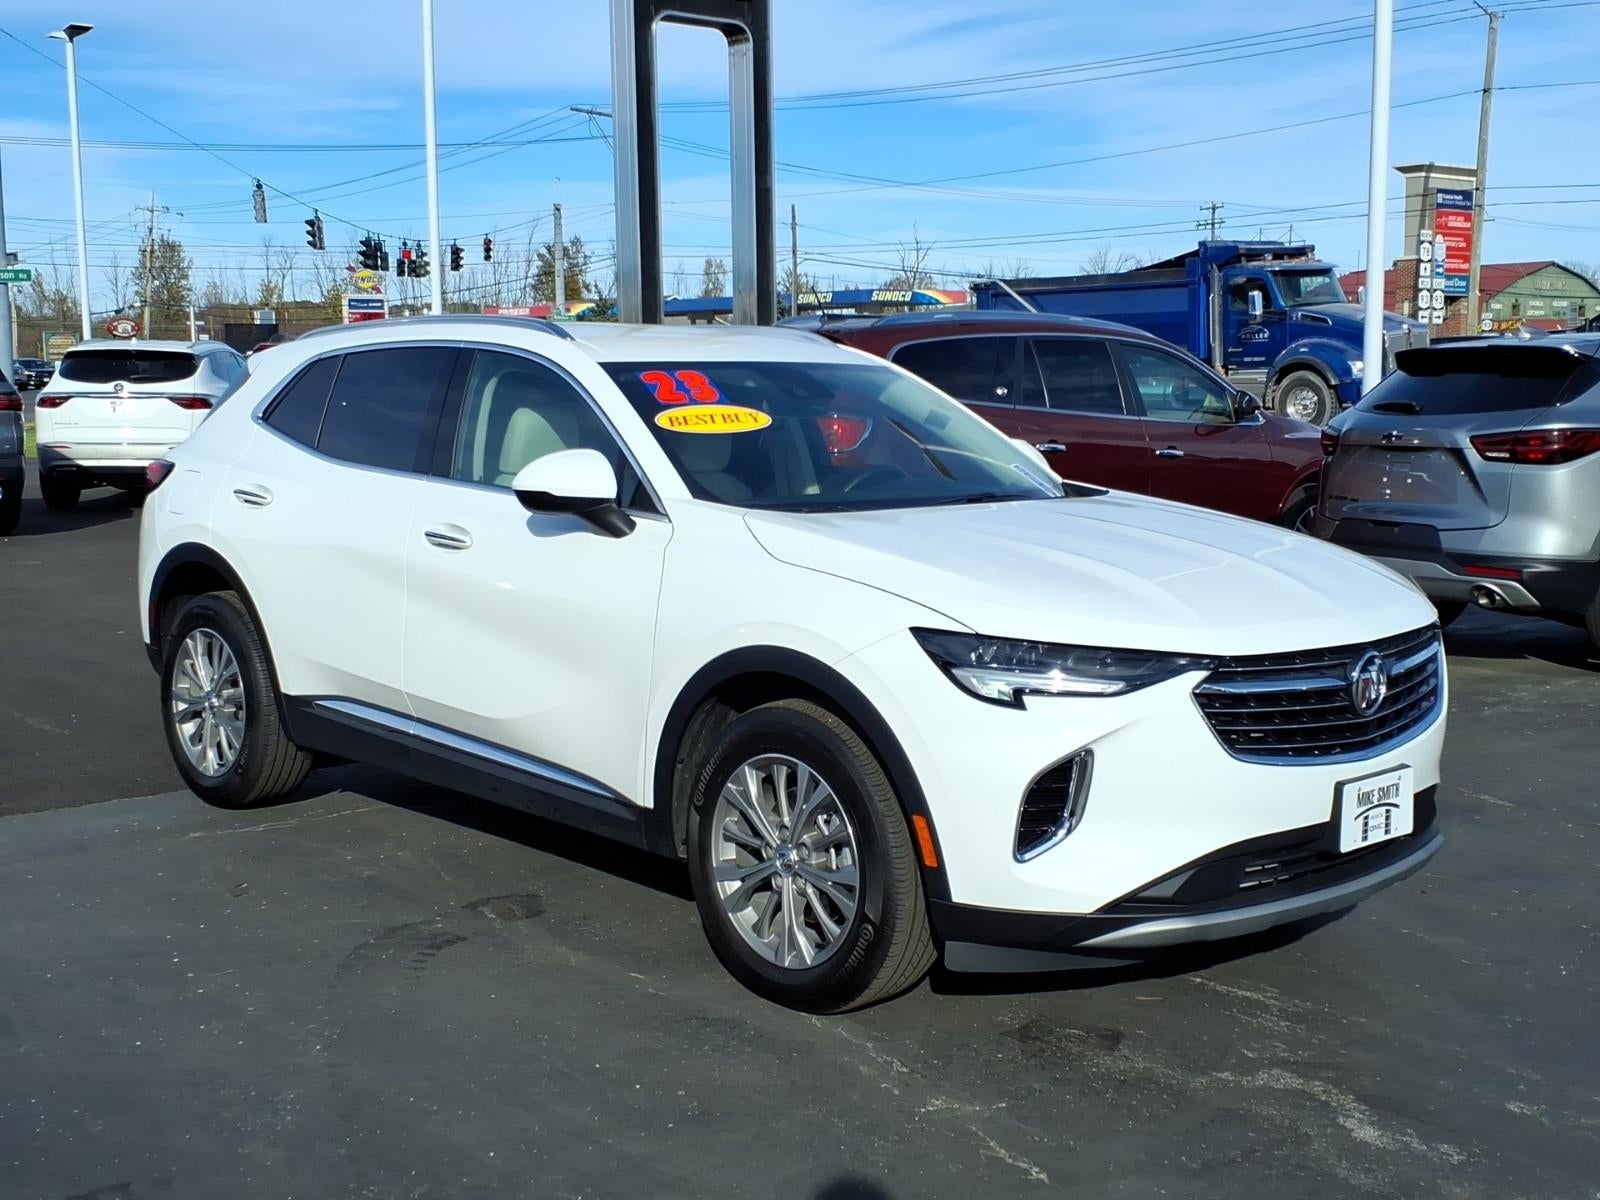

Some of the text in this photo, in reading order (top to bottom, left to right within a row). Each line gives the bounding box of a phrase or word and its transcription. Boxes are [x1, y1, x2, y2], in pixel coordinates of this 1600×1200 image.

[1423, 246, 1430, 257] 78
[346, 274, 384, 285] SUNOCO
[797, 292, 833, 304] SUNOCO
[871, 290, 912, 302] SUNOCO
[640, 370, 720, 404] 23
[667, 412, 760, 428] BEST BUY
[1356, 783, 1400, 809] MIKE SMITH
